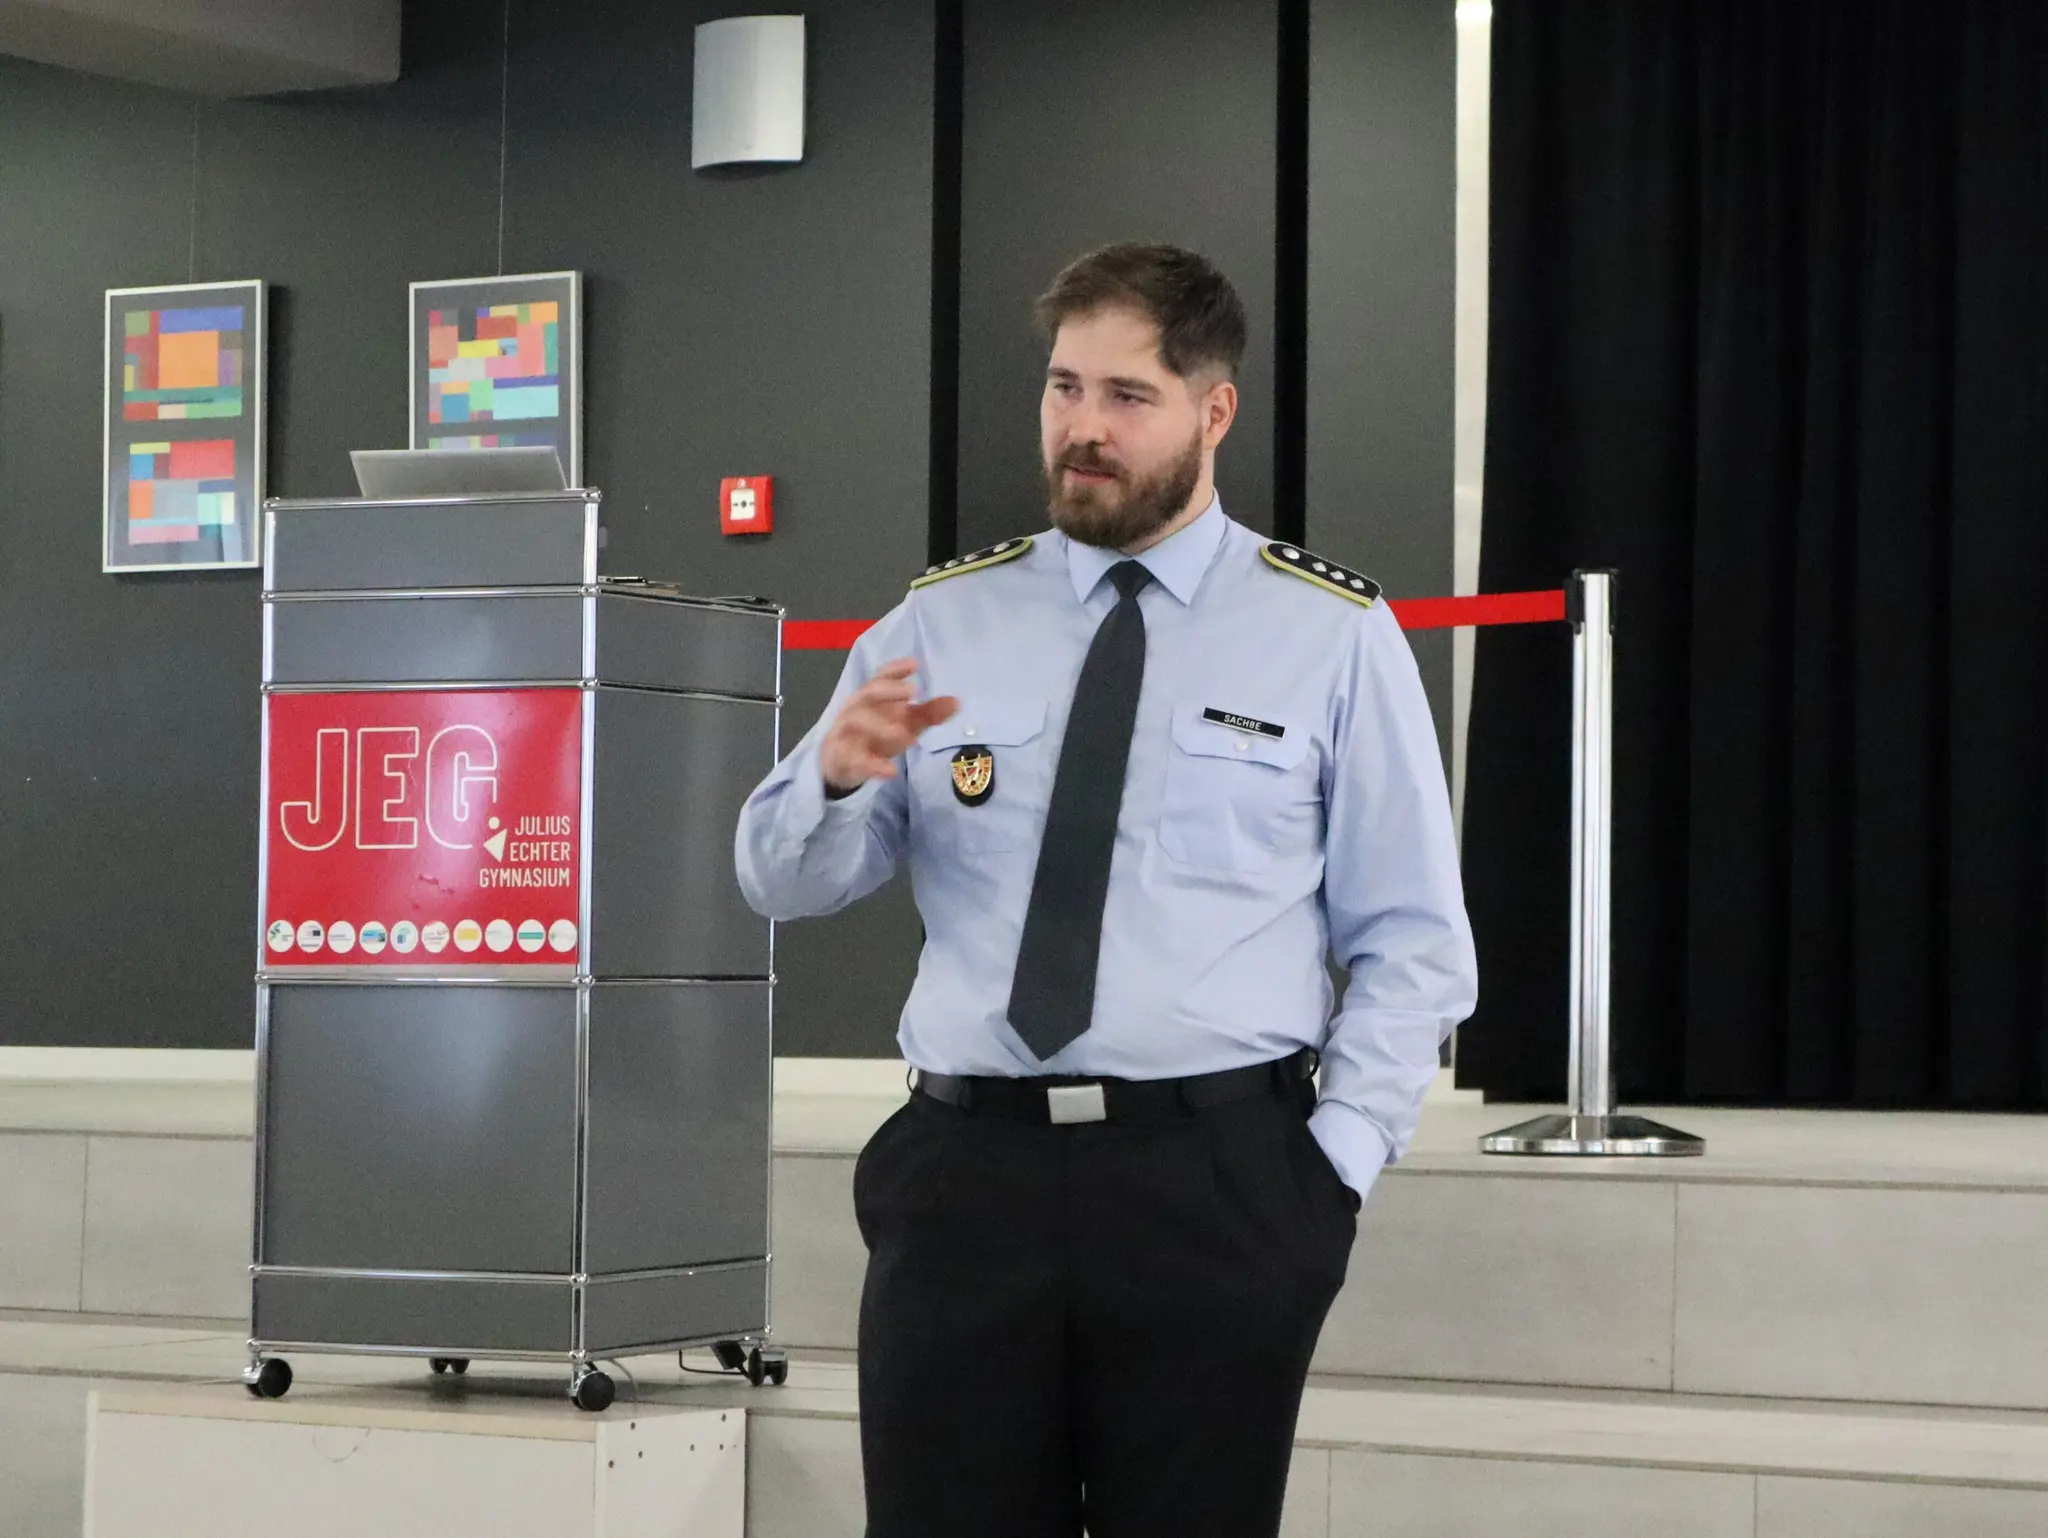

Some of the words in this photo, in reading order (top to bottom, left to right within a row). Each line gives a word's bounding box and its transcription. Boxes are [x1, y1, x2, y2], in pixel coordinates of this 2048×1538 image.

[280, 724, 498, 851] JEG
[514, 815, 571, 836] JULIUS
[509, 841, 571, 862] ECHTER
[479, 867, 571, 889] GYMNASIUM
